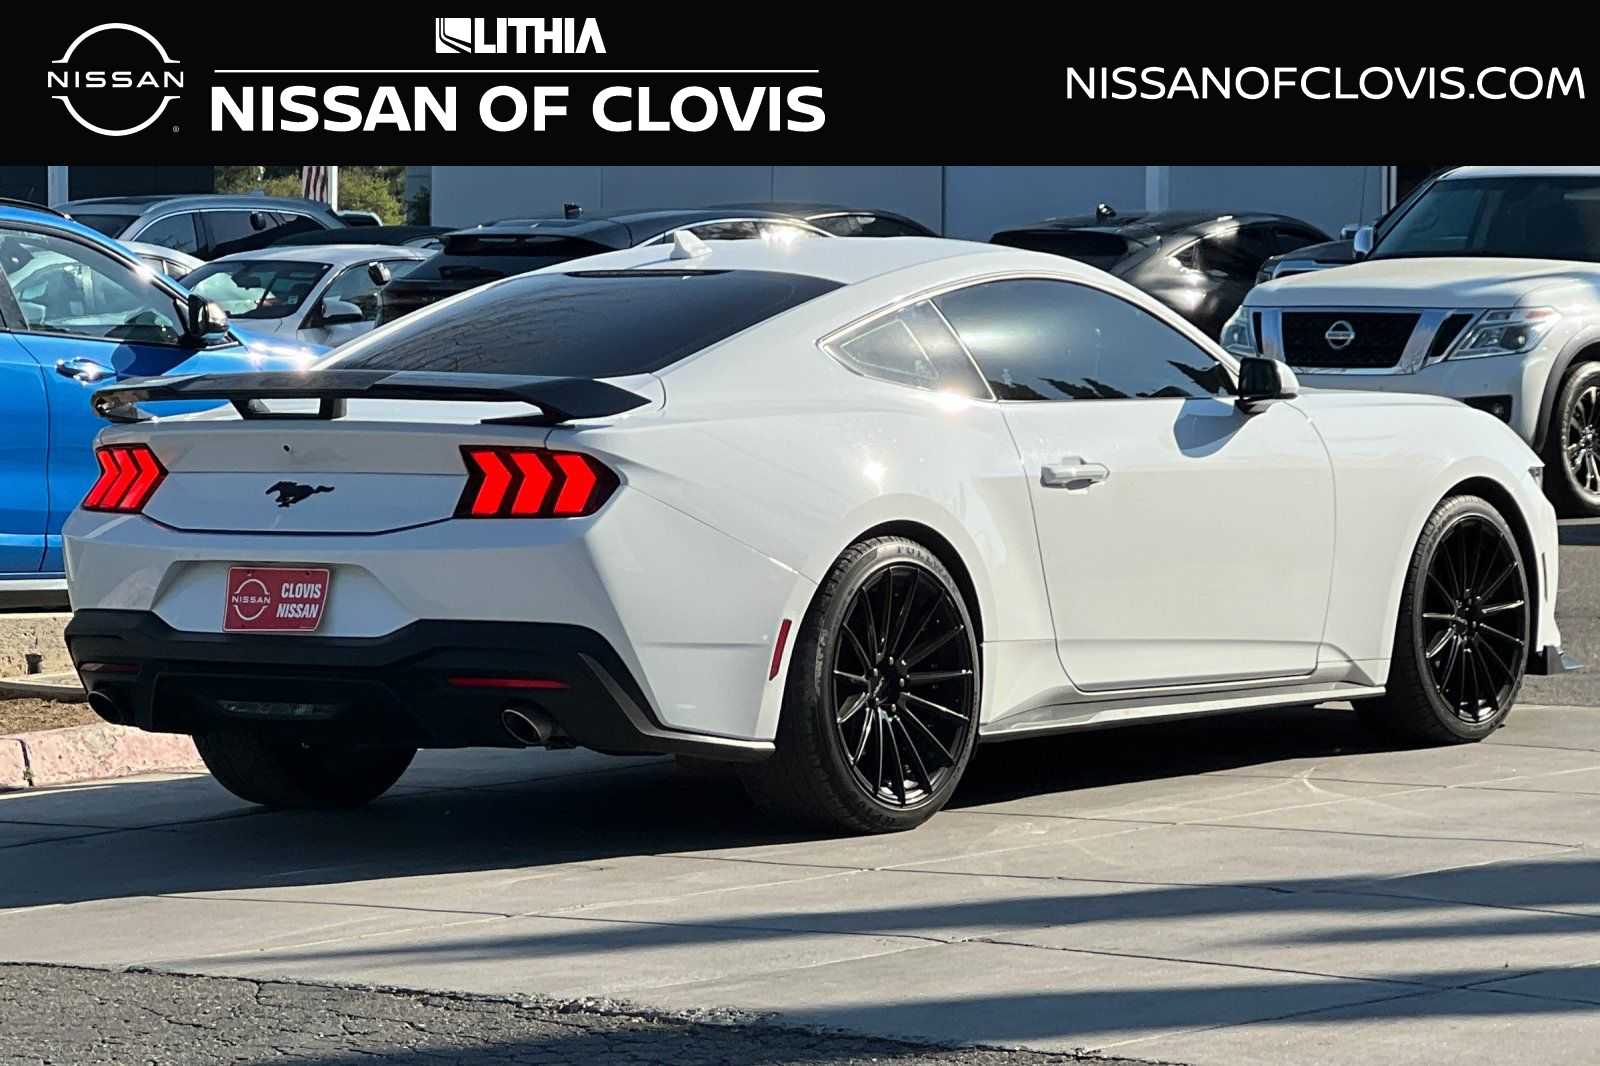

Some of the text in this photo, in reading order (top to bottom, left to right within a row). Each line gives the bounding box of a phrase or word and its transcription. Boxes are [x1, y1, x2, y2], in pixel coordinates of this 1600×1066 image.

[281, 582, 322, 599] CLOVIS
[232, 595, 271, 604] NISSAN
[276, 603, 319, 618] NISSAN
